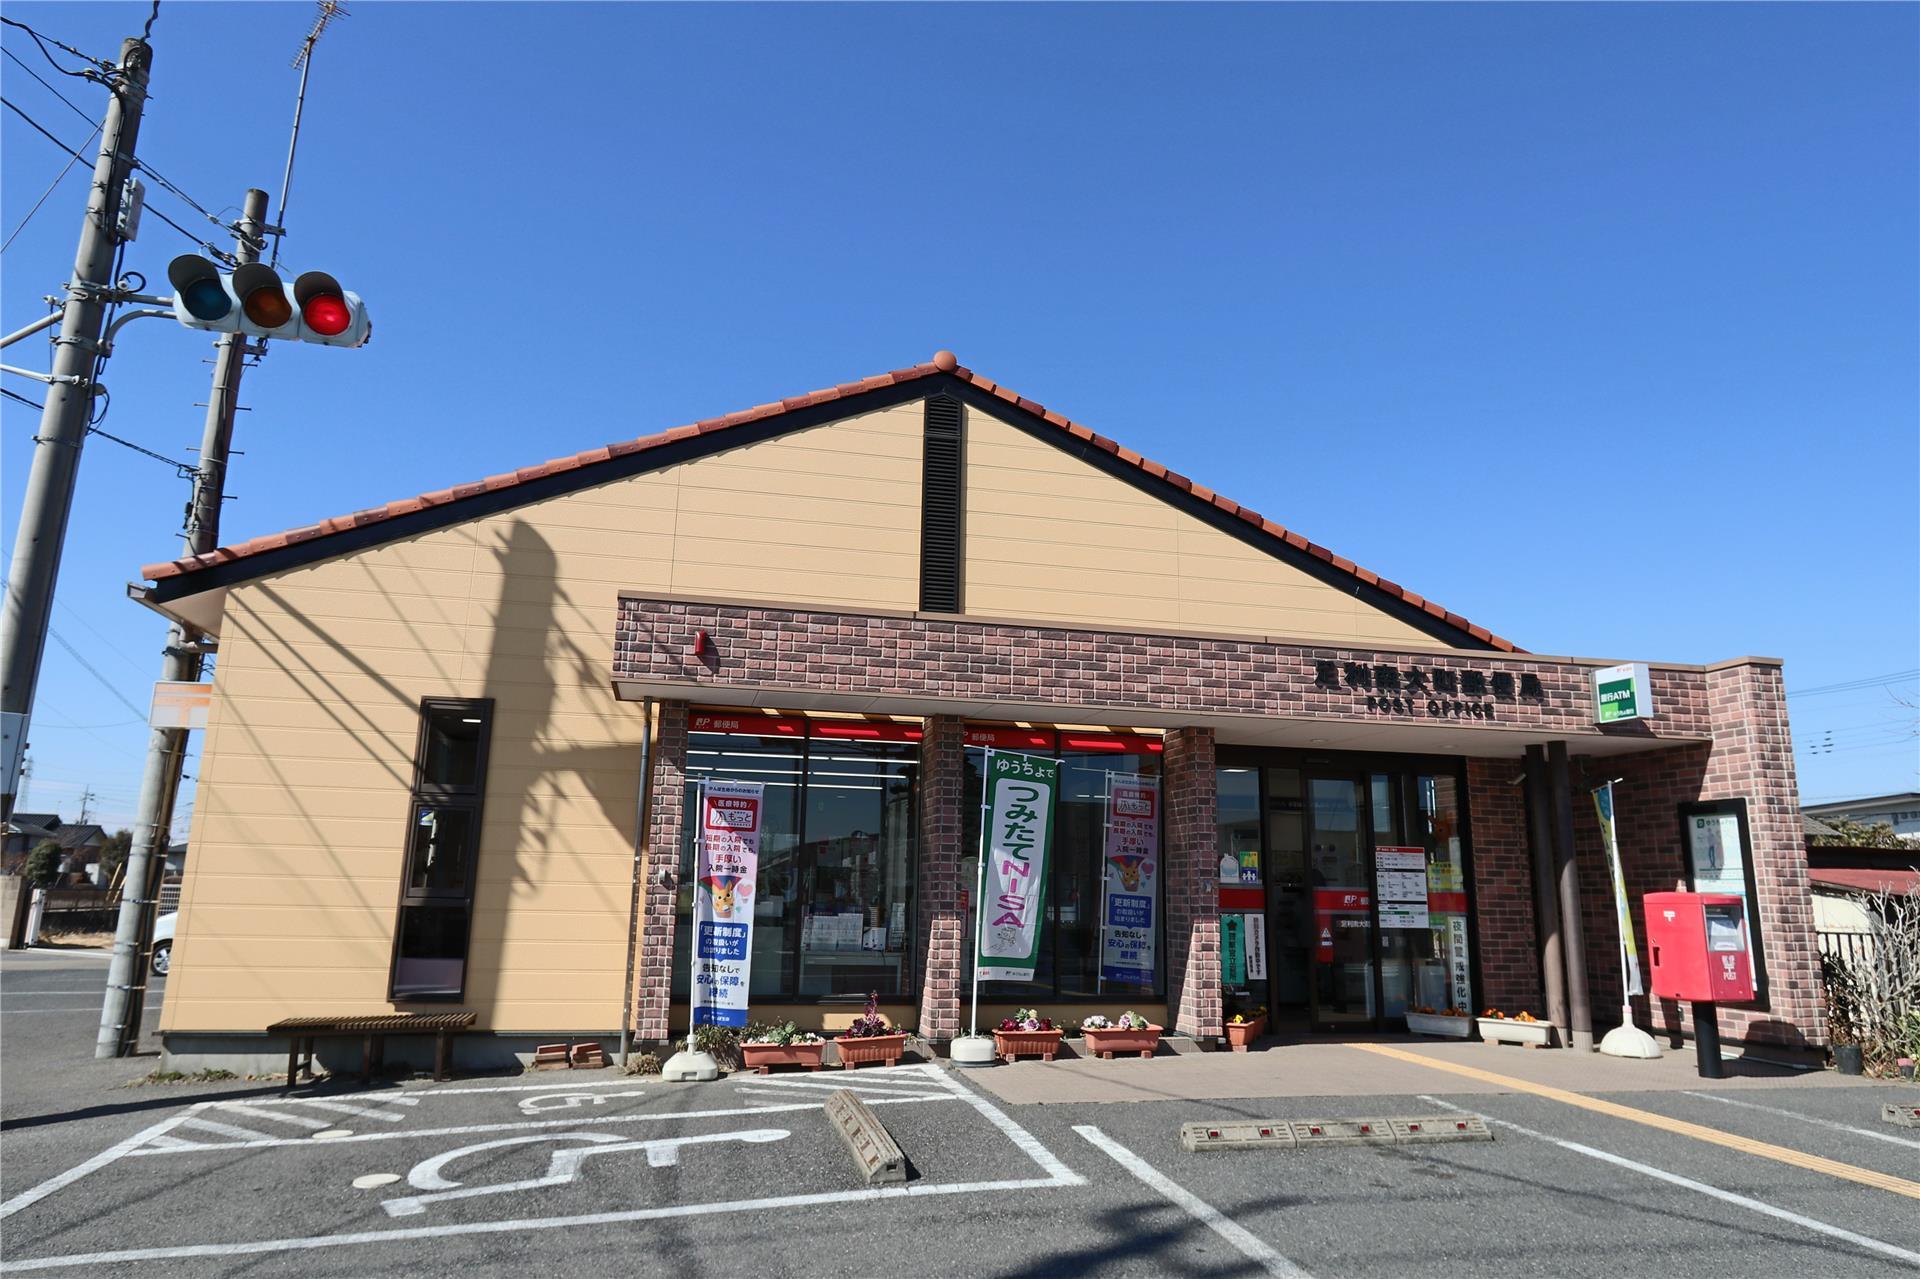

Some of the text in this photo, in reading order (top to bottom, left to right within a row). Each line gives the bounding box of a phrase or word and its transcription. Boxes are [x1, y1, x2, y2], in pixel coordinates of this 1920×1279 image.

[1368, 696, 1495, 720] POST OFFICE
[713, 720, 739, 729] 郵便局
[996, 758, 1054, 778] ゆうちょで
[728, 812, 752, 823] もっと
[715, 853, 742, 864] 手厚い
[707, 863, 748, 874] 入院一時金
[702, 963, 741, 974] 告知なしで
